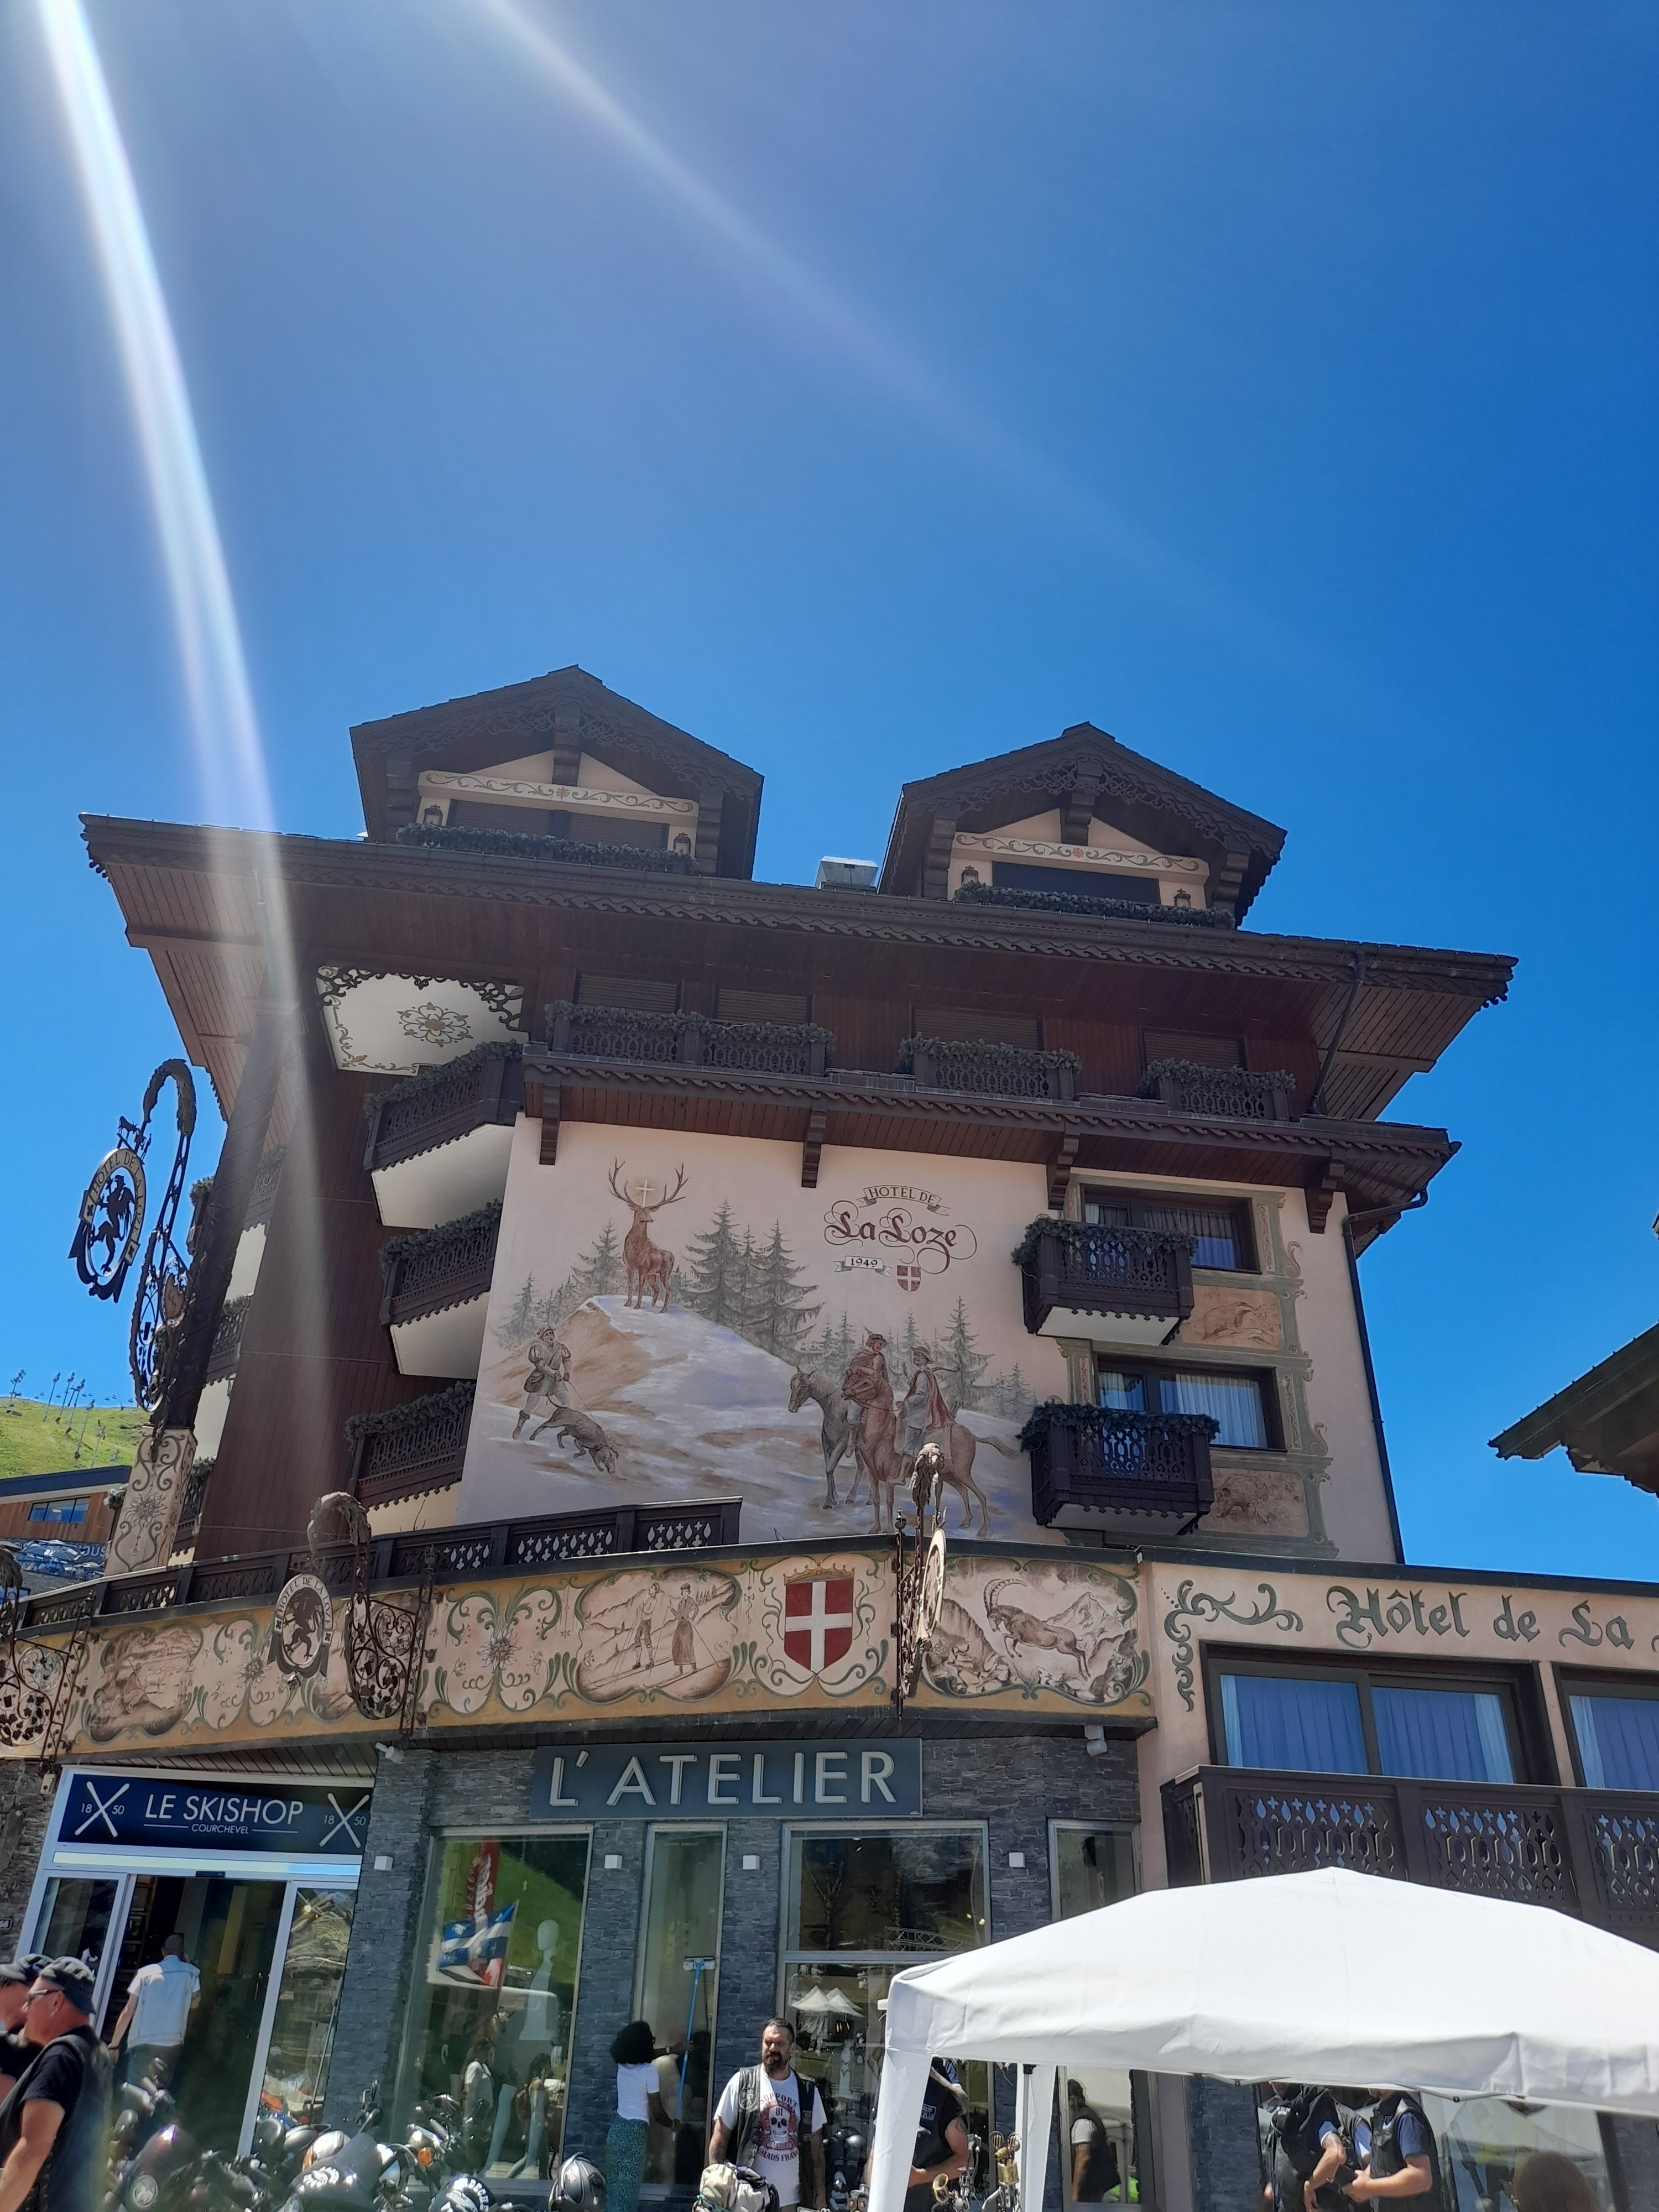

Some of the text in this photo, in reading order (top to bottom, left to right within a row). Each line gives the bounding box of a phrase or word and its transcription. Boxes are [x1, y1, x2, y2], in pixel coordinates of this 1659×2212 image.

[93, 1152, 143, 1235] HOTEL DE LA LOZE
[868, 1186, 936, 1204] HOTEL DE
[824, 1202, 877, 1245] La
[850, 1258, 878, 1267] 1949
[278, 1580, 299, 1613] HOTEL
[302, 1577, 312, 1585] DE
[314, 1580, 324, 1594] LA
[1327, 1585, 1635, 1650] Hôtel de La
[606, 1750, 897, 1806] ATELIER
[81, 1803, 125, 1815] 18 50
[145, 1793, 304, 1825] LE SKISHOP
[324, 1814, 367, 1827] 18 50
[191, 1823, 249, 1835] COURCHEVEL
[760, 2092, 798, 2107] SUPPORT
[775, 2107, 783, 2116] 81
[757, 2147, 780, 2162] OMADS
